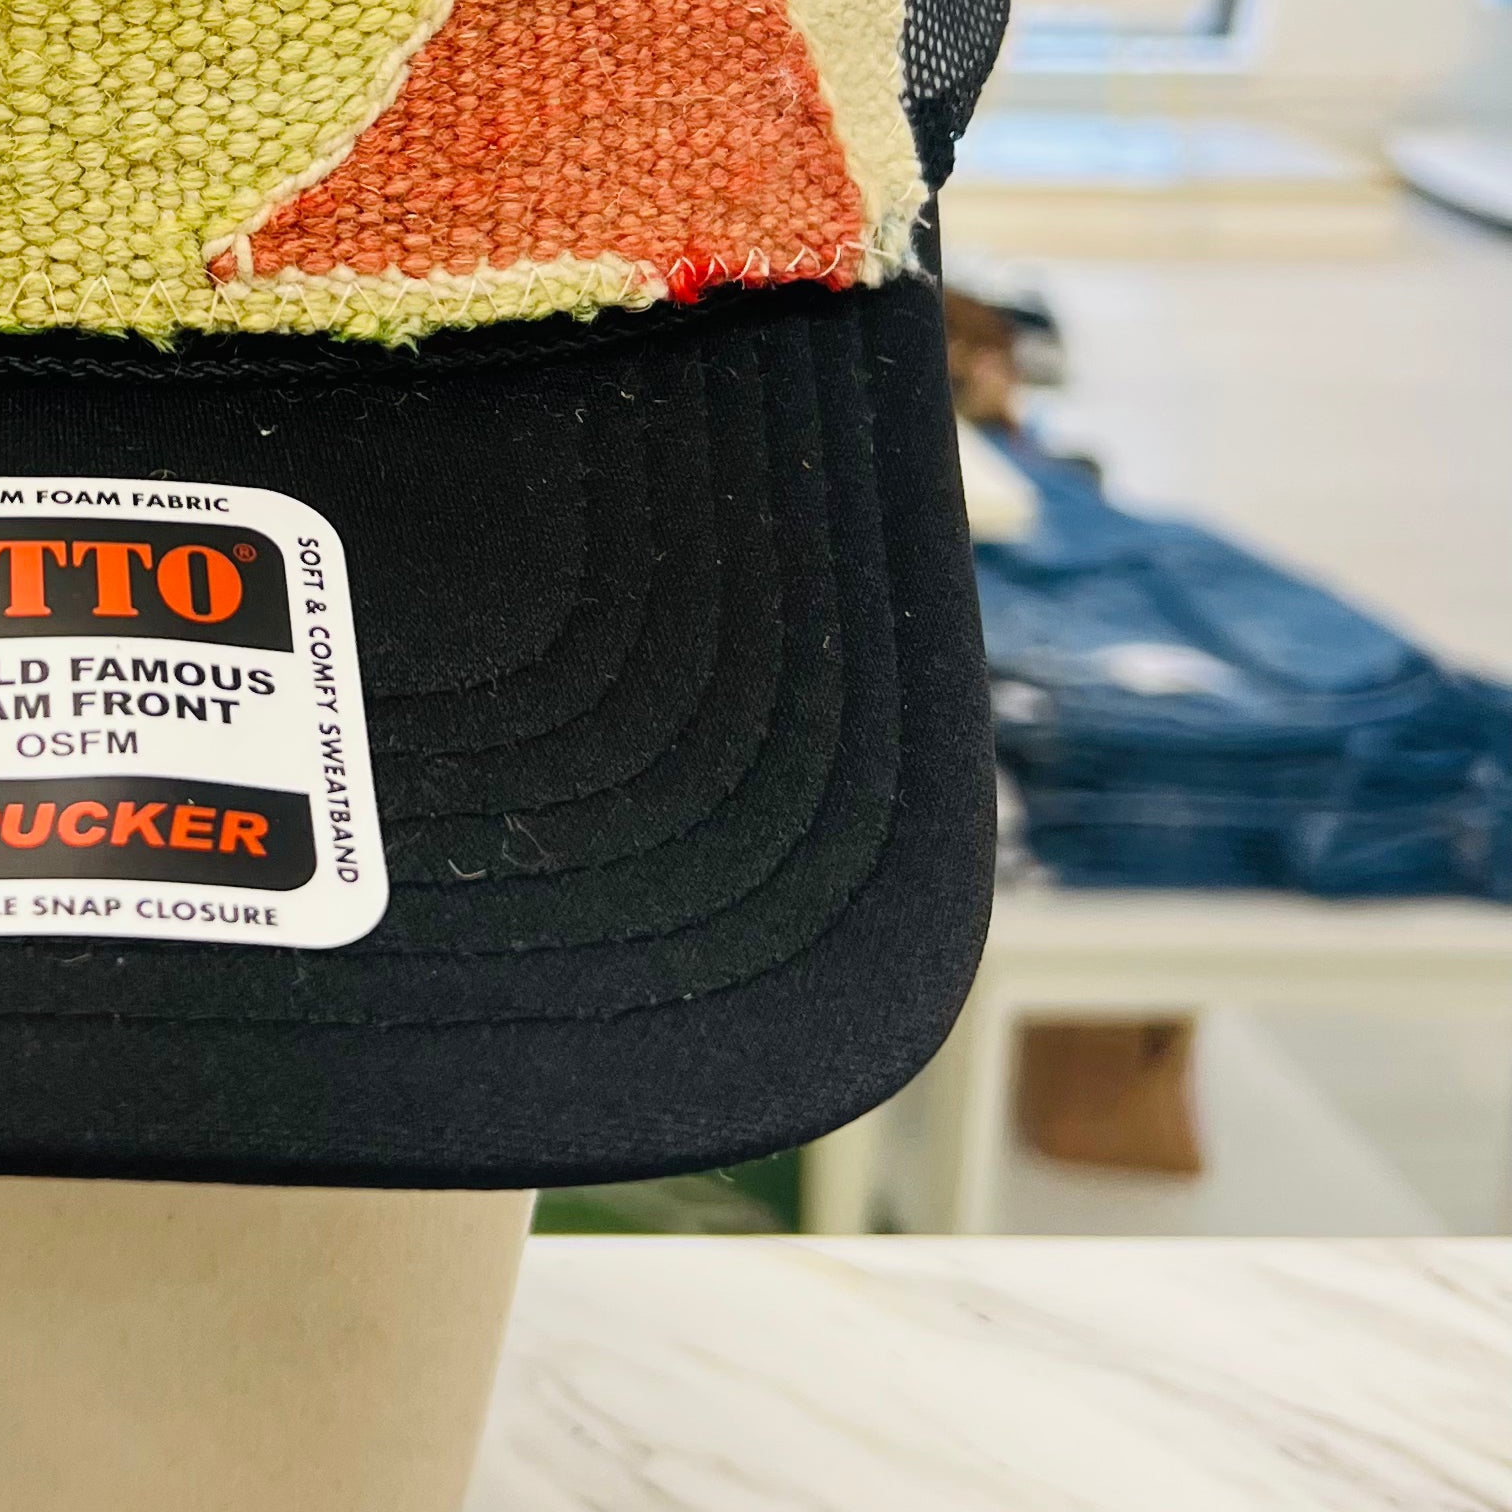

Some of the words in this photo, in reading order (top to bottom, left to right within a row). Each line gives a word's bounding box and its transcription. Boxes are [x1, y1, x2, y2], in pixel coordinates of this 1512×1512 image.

[36, 490, 121, 506] FOAM
[132, 492, 230, 513] FABRIC
[297, 537, 325, 591] SOFT
[305, 598, 327, 615] &
[70, 657, 276, 696] FAMOUS
[308, 626, 339, 714] COMFY
[72, 691, 241, 725] FRONT
[16, 730, 138, 758] OSFM
[318, 723, 359, 883] SWEATBAND
[33, 898, 121, 916] SNAP
[136, 899, 277, 926] CLOSURE
